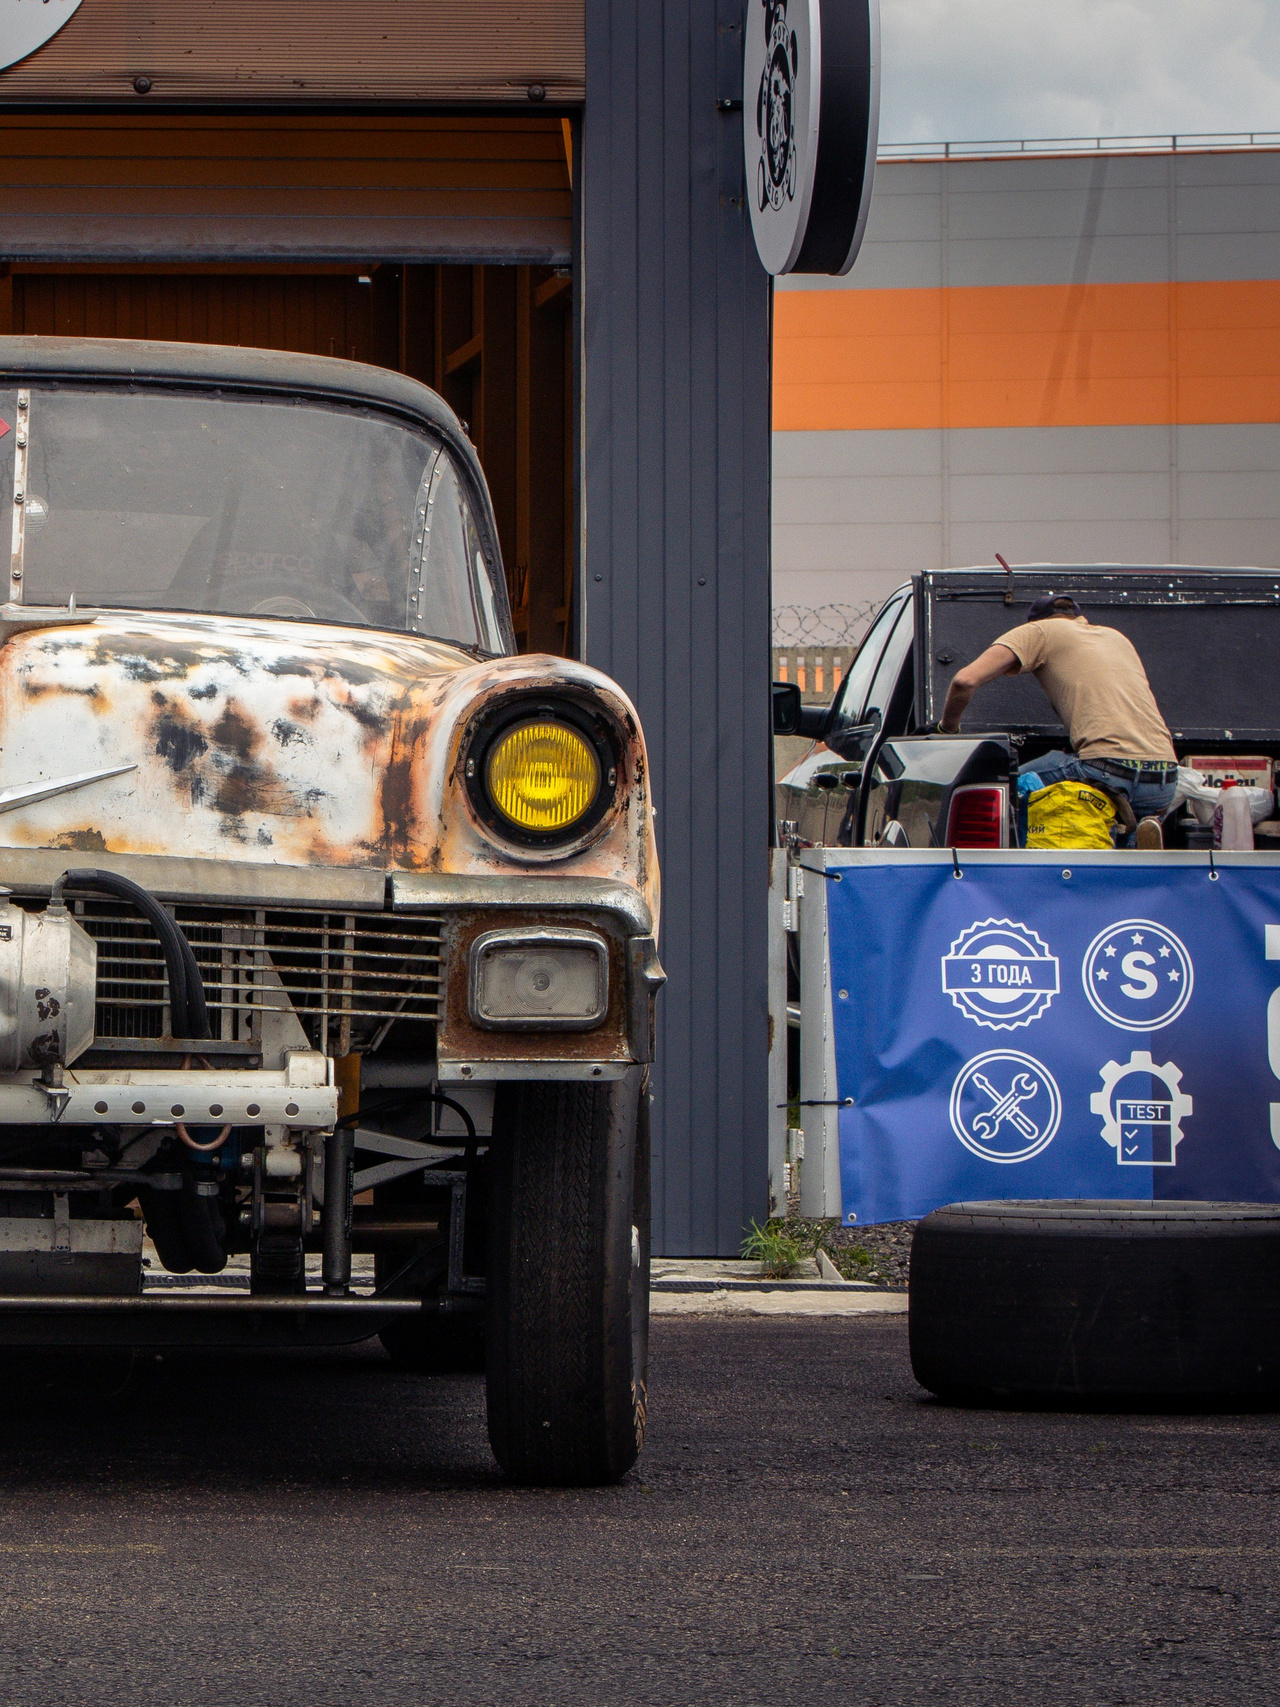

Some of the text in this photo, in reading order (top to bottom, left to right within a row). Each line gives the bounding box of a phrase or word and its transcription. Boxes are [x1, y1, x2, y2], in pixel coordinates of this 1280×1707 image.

[971, 963, 1033, 986] 3 ГОДА
[1120, 951, 1158, 999] S
[1127, 1104, 1164, 1119] TEST
